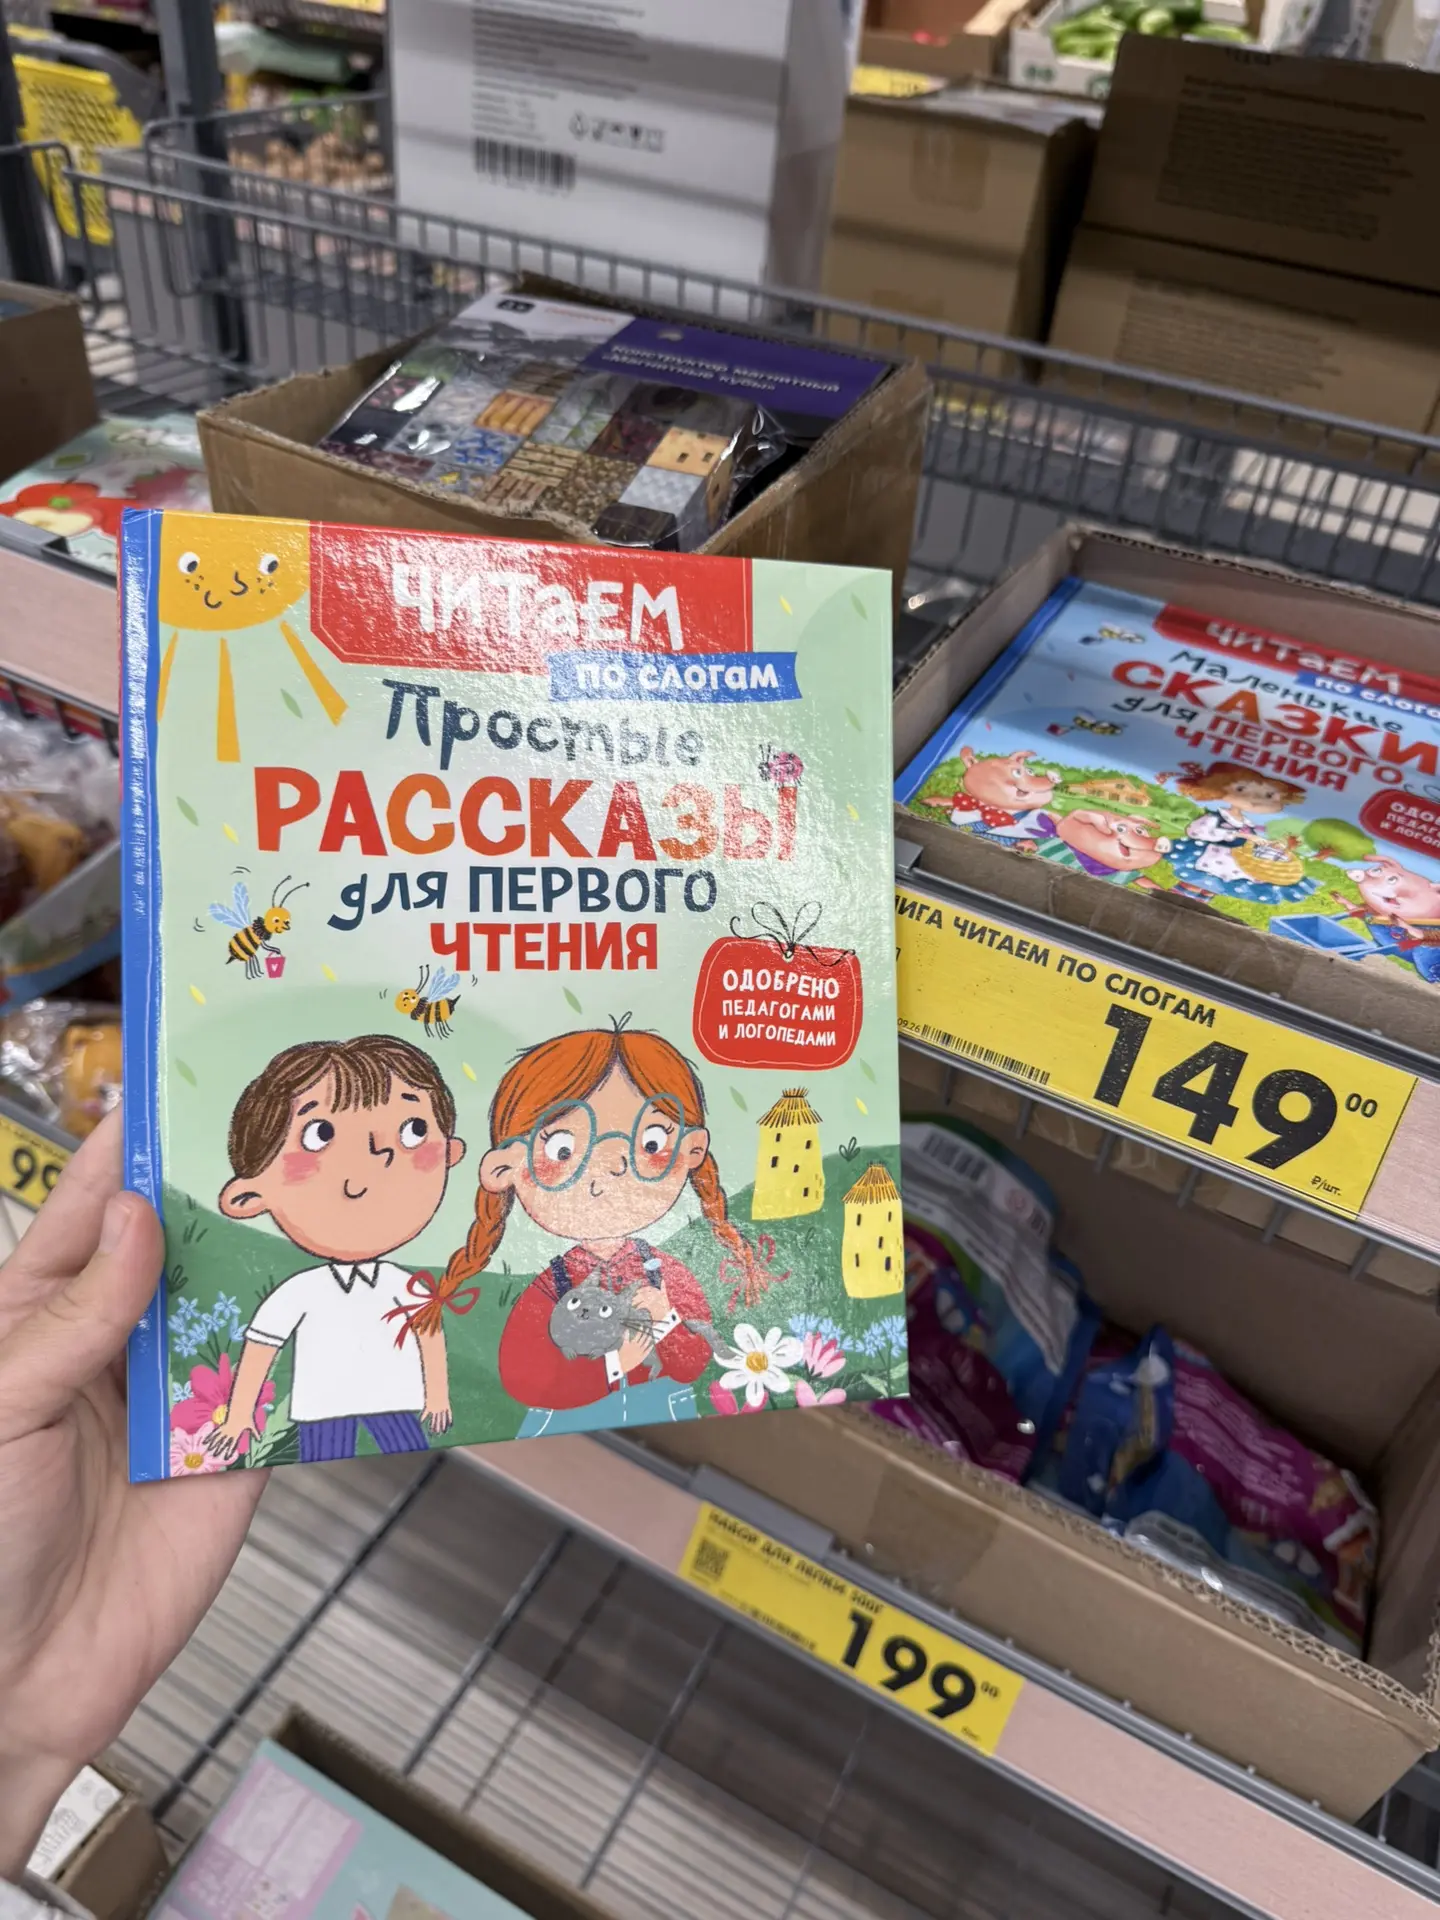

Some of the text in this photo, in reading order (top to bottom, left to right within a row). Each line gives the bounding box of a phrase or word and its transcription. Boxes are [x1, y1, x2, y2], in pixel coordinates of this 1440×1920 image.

[383, 678, 705, 771] Простые
[1112, 660, 1439, 777] СКАЗКИ
[1170, 650, 1404, 733] Маленькие
[1111, 696, 1405, 786] для ПЕРВОГО
[1175, 725, 1350, 793] ЧТЕНИЯ
[254, 766, 798, 862] РАССКАЗЫ
[327, 865, 718, 931] для ПЕРВОГО
[430, 922, 658, 972] ЧТЕНИЯ
[722, 969, 840, 999] ОДОБРЕНО
[953, 915, 1050, 968] ЧИТАЕМ
[1056, 953, 1097, 984] ПО
[1105, 973, 1217, 1028] СЛОГАМ
[718, 1023, 836, 1047] И ЛОГОПЕДАМИ
[722, 999, 836, 1021] ПЕДАГОГАМИ
[1093, 1002, 1378, 1170] 149 00
[840, 1607, 977, 1721] 199
